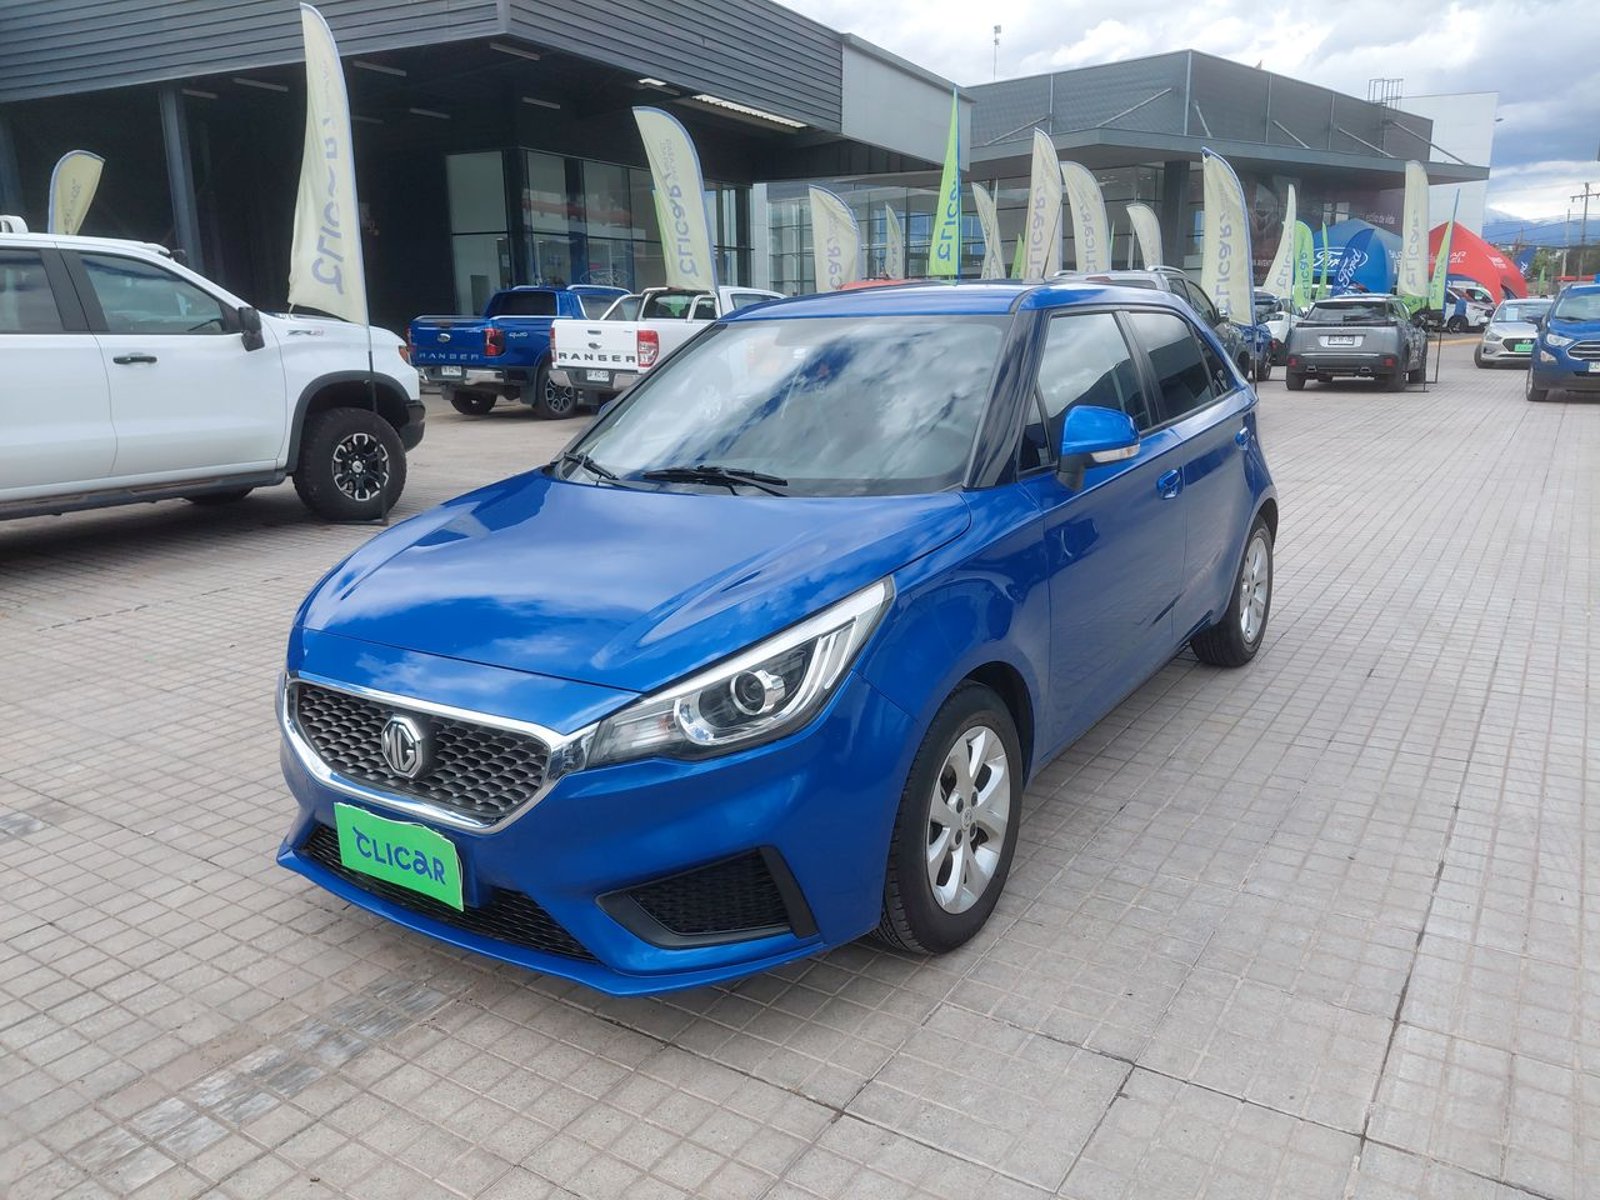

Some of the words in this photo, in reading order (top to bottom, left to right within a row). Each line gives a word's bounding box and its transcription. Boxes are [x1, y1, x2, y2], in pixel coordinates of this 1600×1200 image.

[1338, 248, 1361, 287] Ford
[419, 353, 480, 361] RANGER
[558, 352, 637, 363] RANGER
[383, 721, 418, 774] MG
